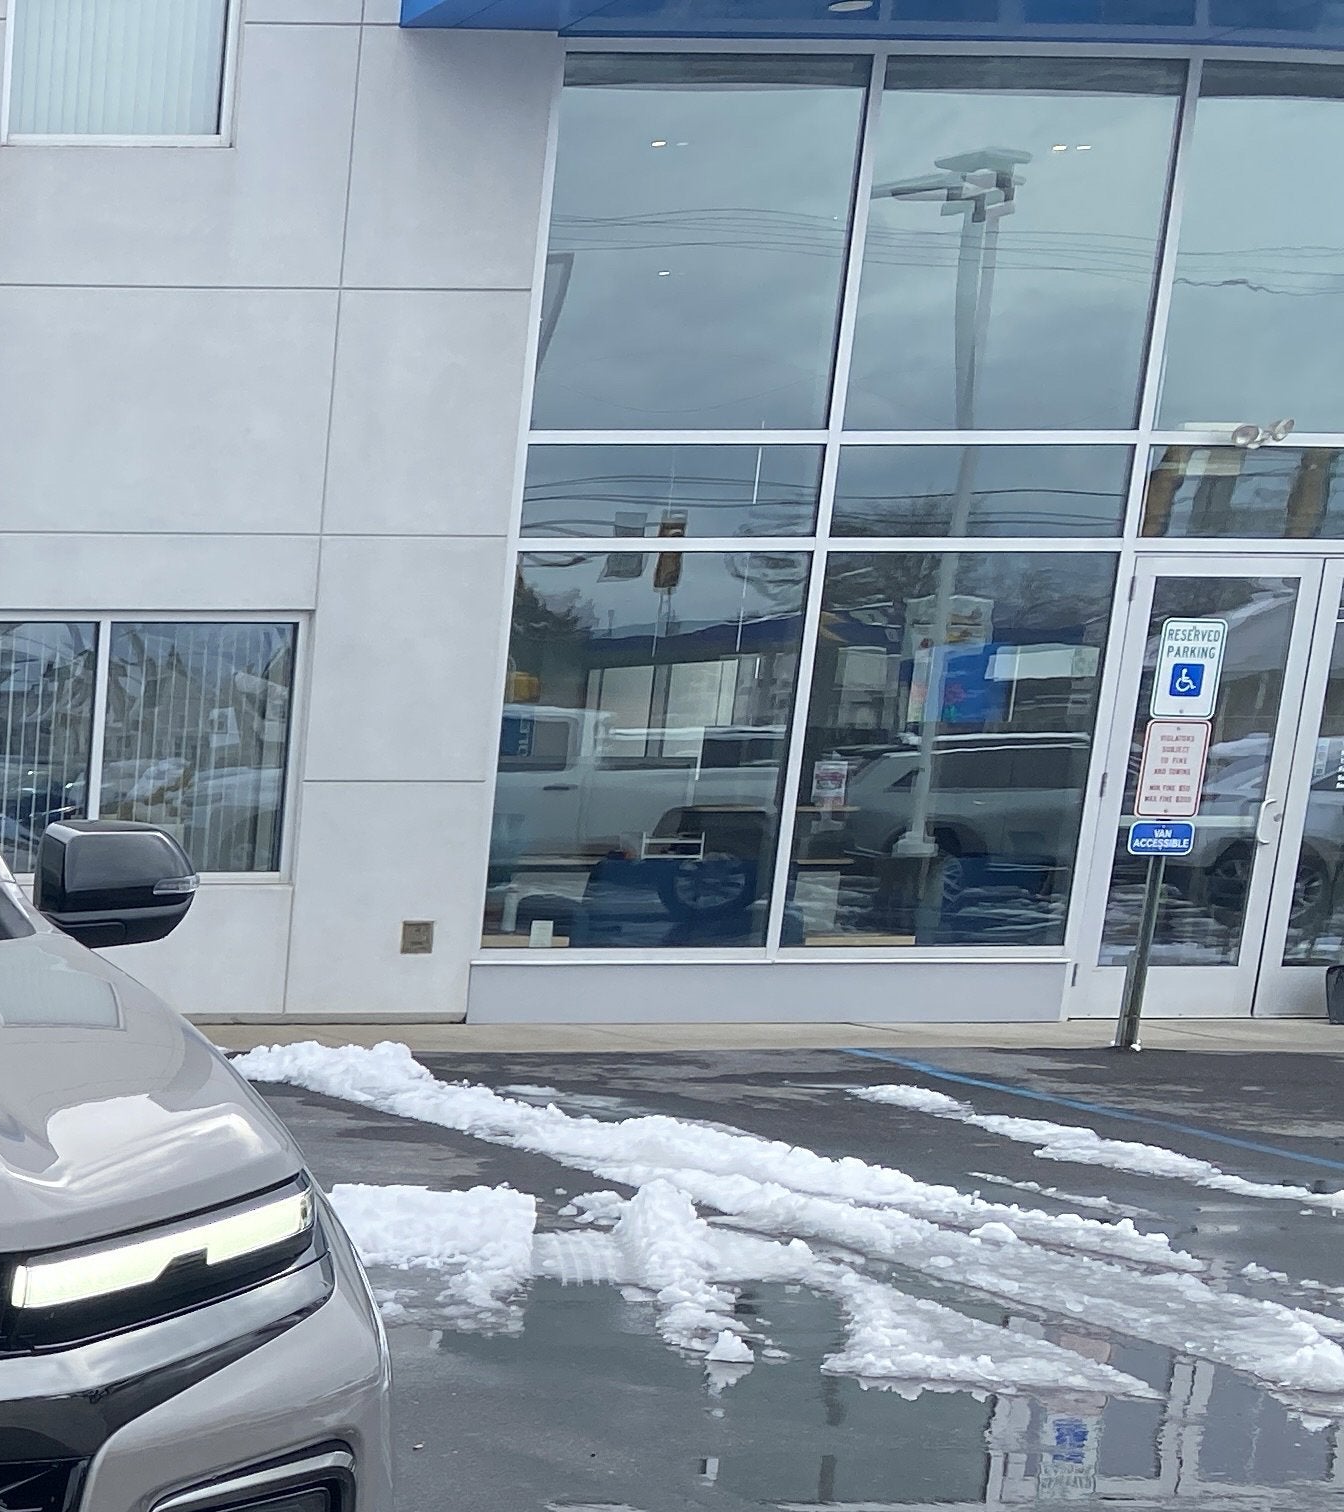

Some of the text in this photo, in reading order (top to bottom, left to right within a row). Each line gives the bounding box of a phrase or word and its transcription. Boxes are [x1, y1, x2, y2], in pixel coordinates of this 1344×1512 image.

[1168, 629, 1220, 642] RESERVED
[1167, 645, 1216, 659] PARKING
[1154, 829, 1172, 838] VAN
[1133, 838, 1189, 848] ACCESSIBLE
